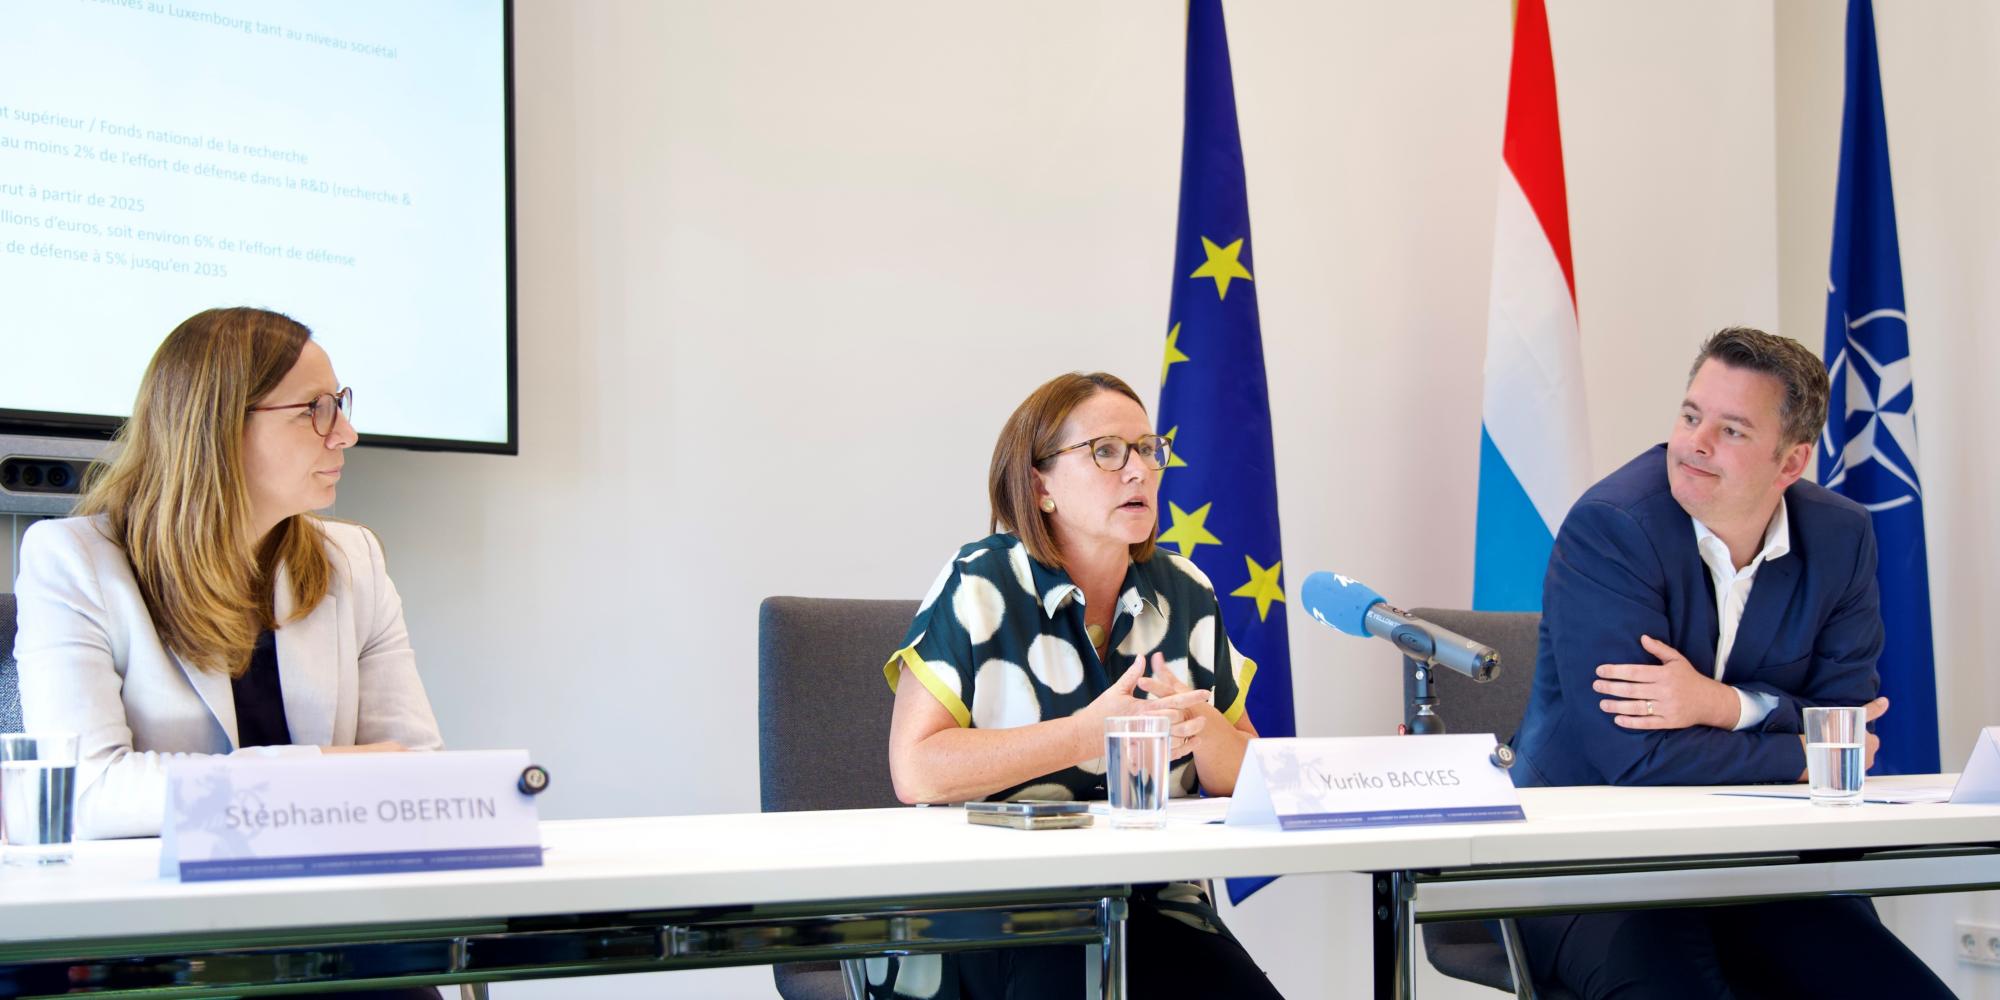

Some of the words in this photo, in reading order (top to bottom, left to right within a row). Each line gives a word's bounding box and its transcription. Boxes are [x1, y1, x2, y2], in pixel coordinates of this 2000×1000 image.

[147, 3, 164, 13] au
[168, 3, 253, 33] Luxembourg
[256, 20, 282, 37] tant
[286, 29, 302, 40] au
[305, 30, 347, 49] niveau
[351, 40, 398, 59] sociétal
[14, 108, 84, 129] supérieur
[88, 117, 97, 132] /
[100, 120, 143, 139] Fonds
[146, 126, 203, 148] national
[207, 137, 225, 151] de
[228, 139, 240, 154] la
[243, 144, 309, 164] recherche
[0, 136, 19, 149] au
[24, 139, 70, 157] moins
[73, 144, 96, 160] 2%
[99, 148, 118, 163] de
[122, 151, 169, 171] l'effort
[172, 159, 190, 174] de
[194, 161, 247, 183] défense
[251, 171, 282, 188] dans
[286, 176, 297, 189] la
[300, 178, 329, 194] R&D
[332, 181, 399, 204] (recherche
[402, 193, 412, 206] &
[0, 184, 24, 197] rut
[29, 183, 37, 198] à
[42, 186, 82, 205] partir
[87, 192, 106, 207] de
[110, 195, 146, 213] 2025
[6, 240, 25, 255] de
[30, 242, 89, 264] défense
[93, 249, 101, 264] à
[106, 251, 127, 266] 5%
[130, 254, 190, 274] jusqu'en
[193, 262, 229, 278] 2035
[107, 223, 132, 239] soit
[137, 229, 191, 247] environ
[194, 234, 215, 249] 6%
[218, 237, 235, 251] de
[239, 239, 283, 258] l'effort
[286, 247, 302, 260] de
[306, 249, 357, 268] défense
[1320, 770, 1384, 791] Yuriko
[1388, 768, 1461, 788] BACKES
[224, 801, 369, 831] Stéphanie
[377, 797, 497, 822] OBERTIN
